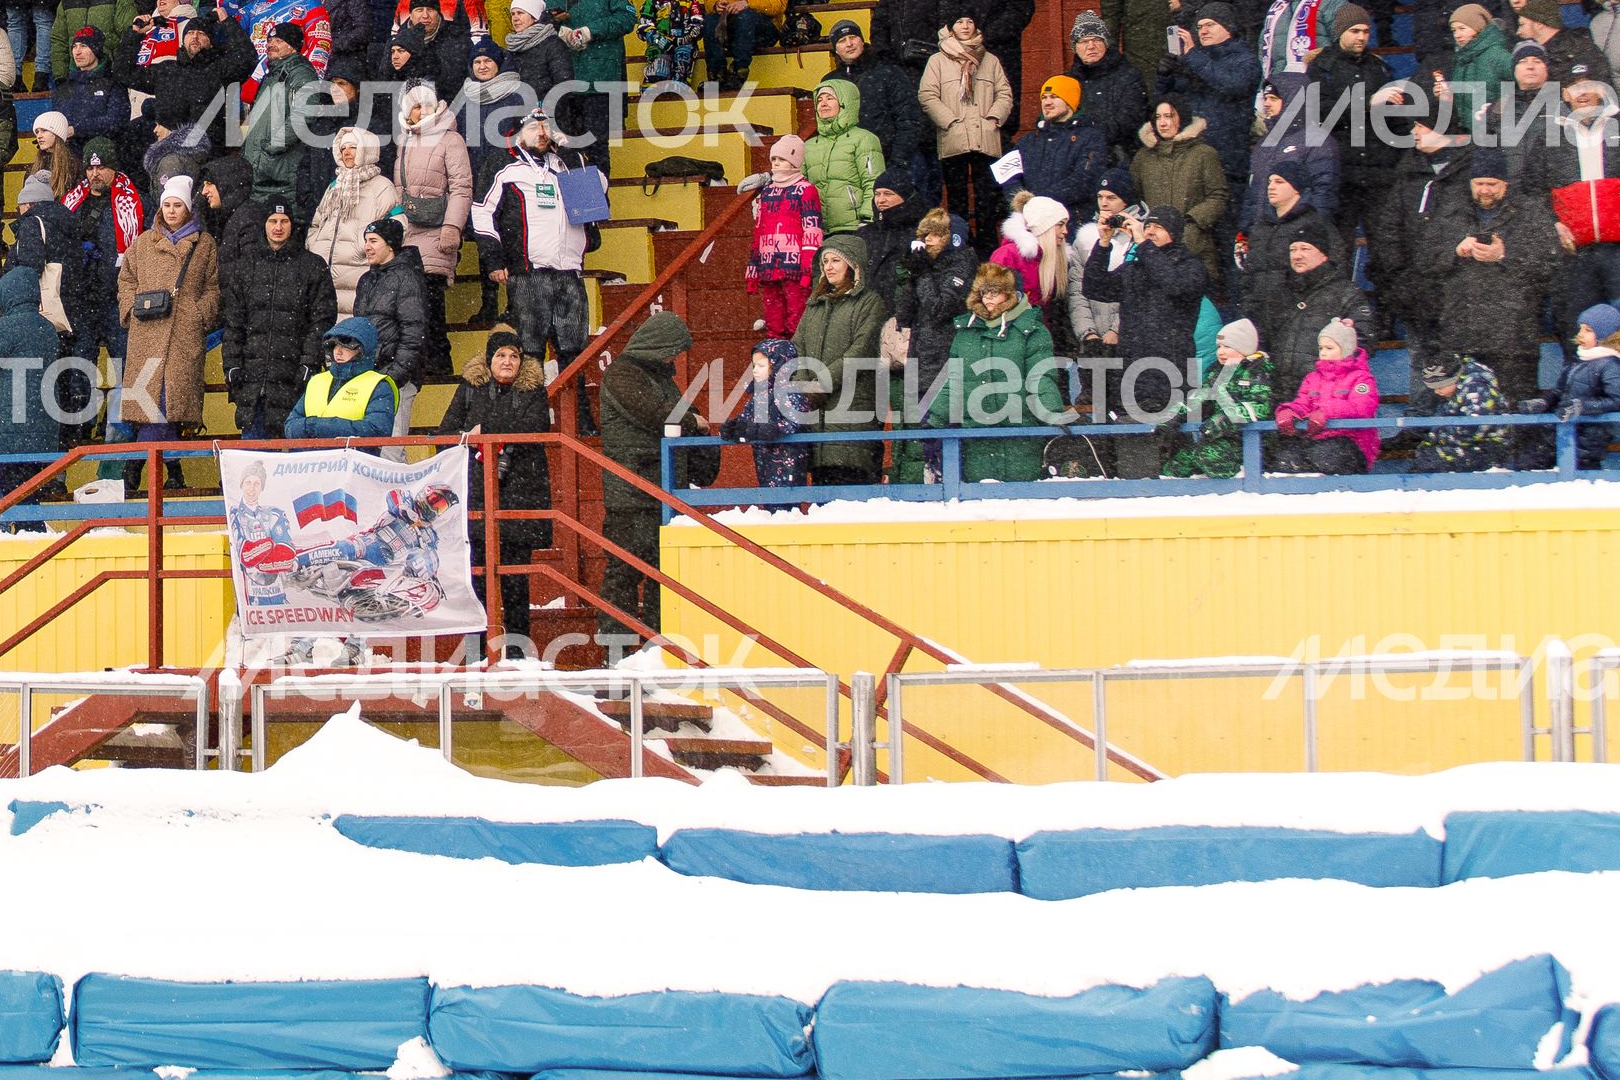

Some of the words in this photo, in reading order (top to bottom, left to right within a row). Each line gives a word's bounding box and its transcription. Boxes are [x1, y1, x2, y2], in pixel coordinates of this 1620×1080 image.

[273, 457, 348, 477] ДМИТРИЙ
[246, 609, 263, 626] ICE
[267, 607, 355, 625] SPEEDWAY
